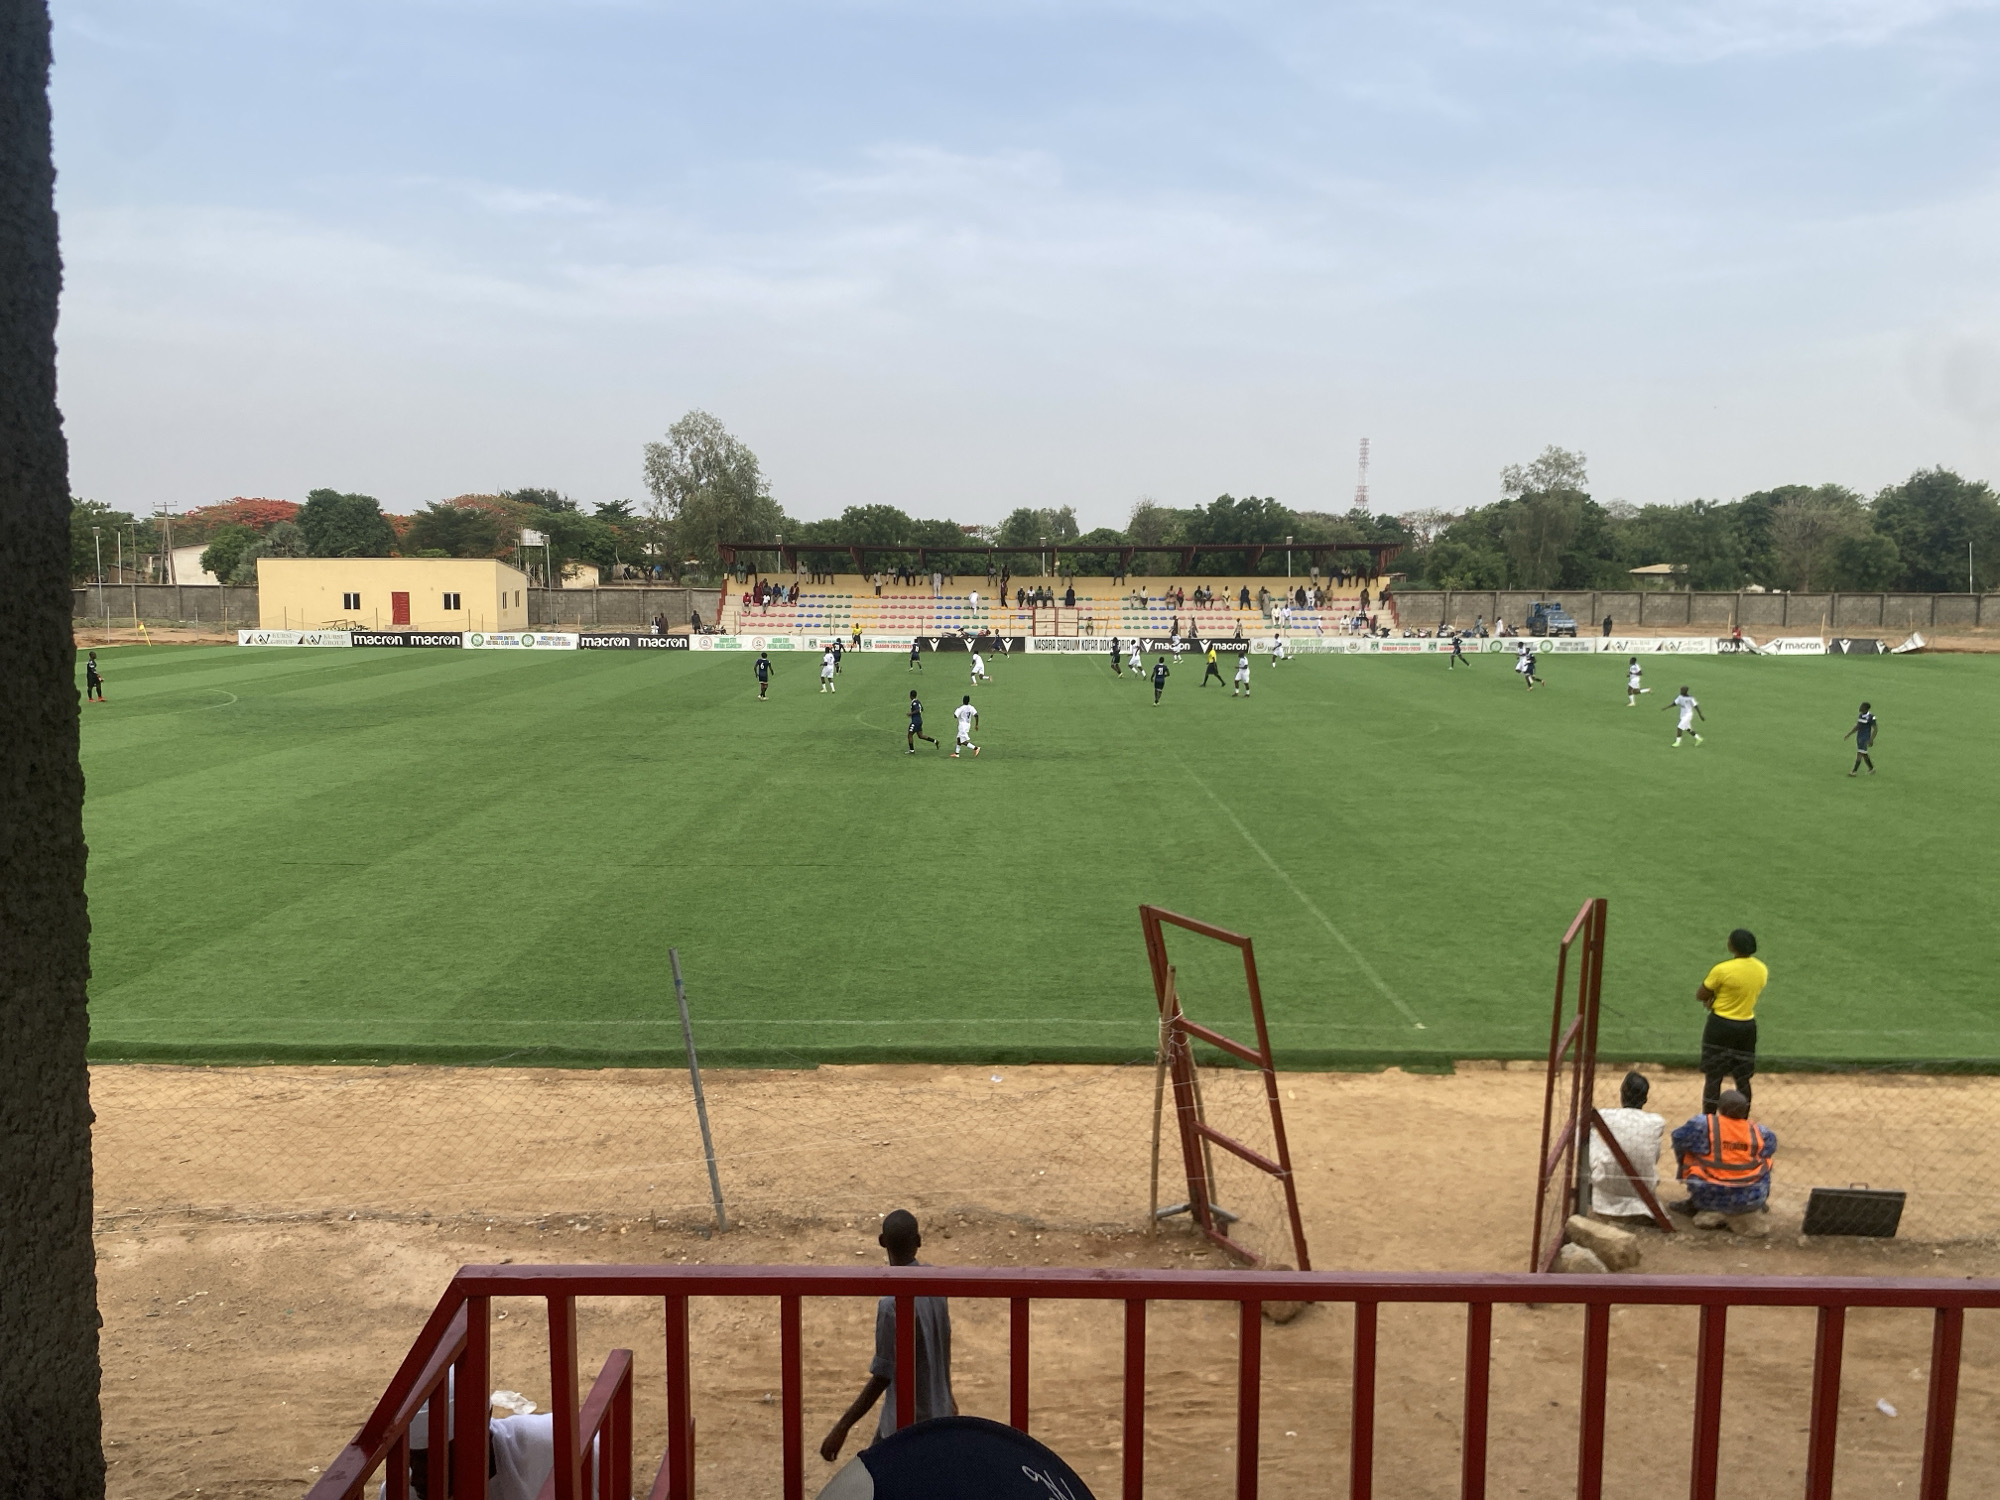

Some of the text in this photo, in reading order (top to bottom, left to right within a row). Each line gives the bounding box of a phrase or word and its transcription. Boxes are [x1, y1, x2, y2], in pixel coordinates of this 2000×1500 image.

[353, 635, 404, 645] macron
[410, 635, 460, 646] macron
[581, 637, 630, 647] macron
[638, 637, 688, 647] macron
[1057, 639, 1080, 651] STADIUM
[1212, 641, 1247, 651] macron
[1785, 642, 1821, 650] macron
[760, 662, 765, 670] 6
